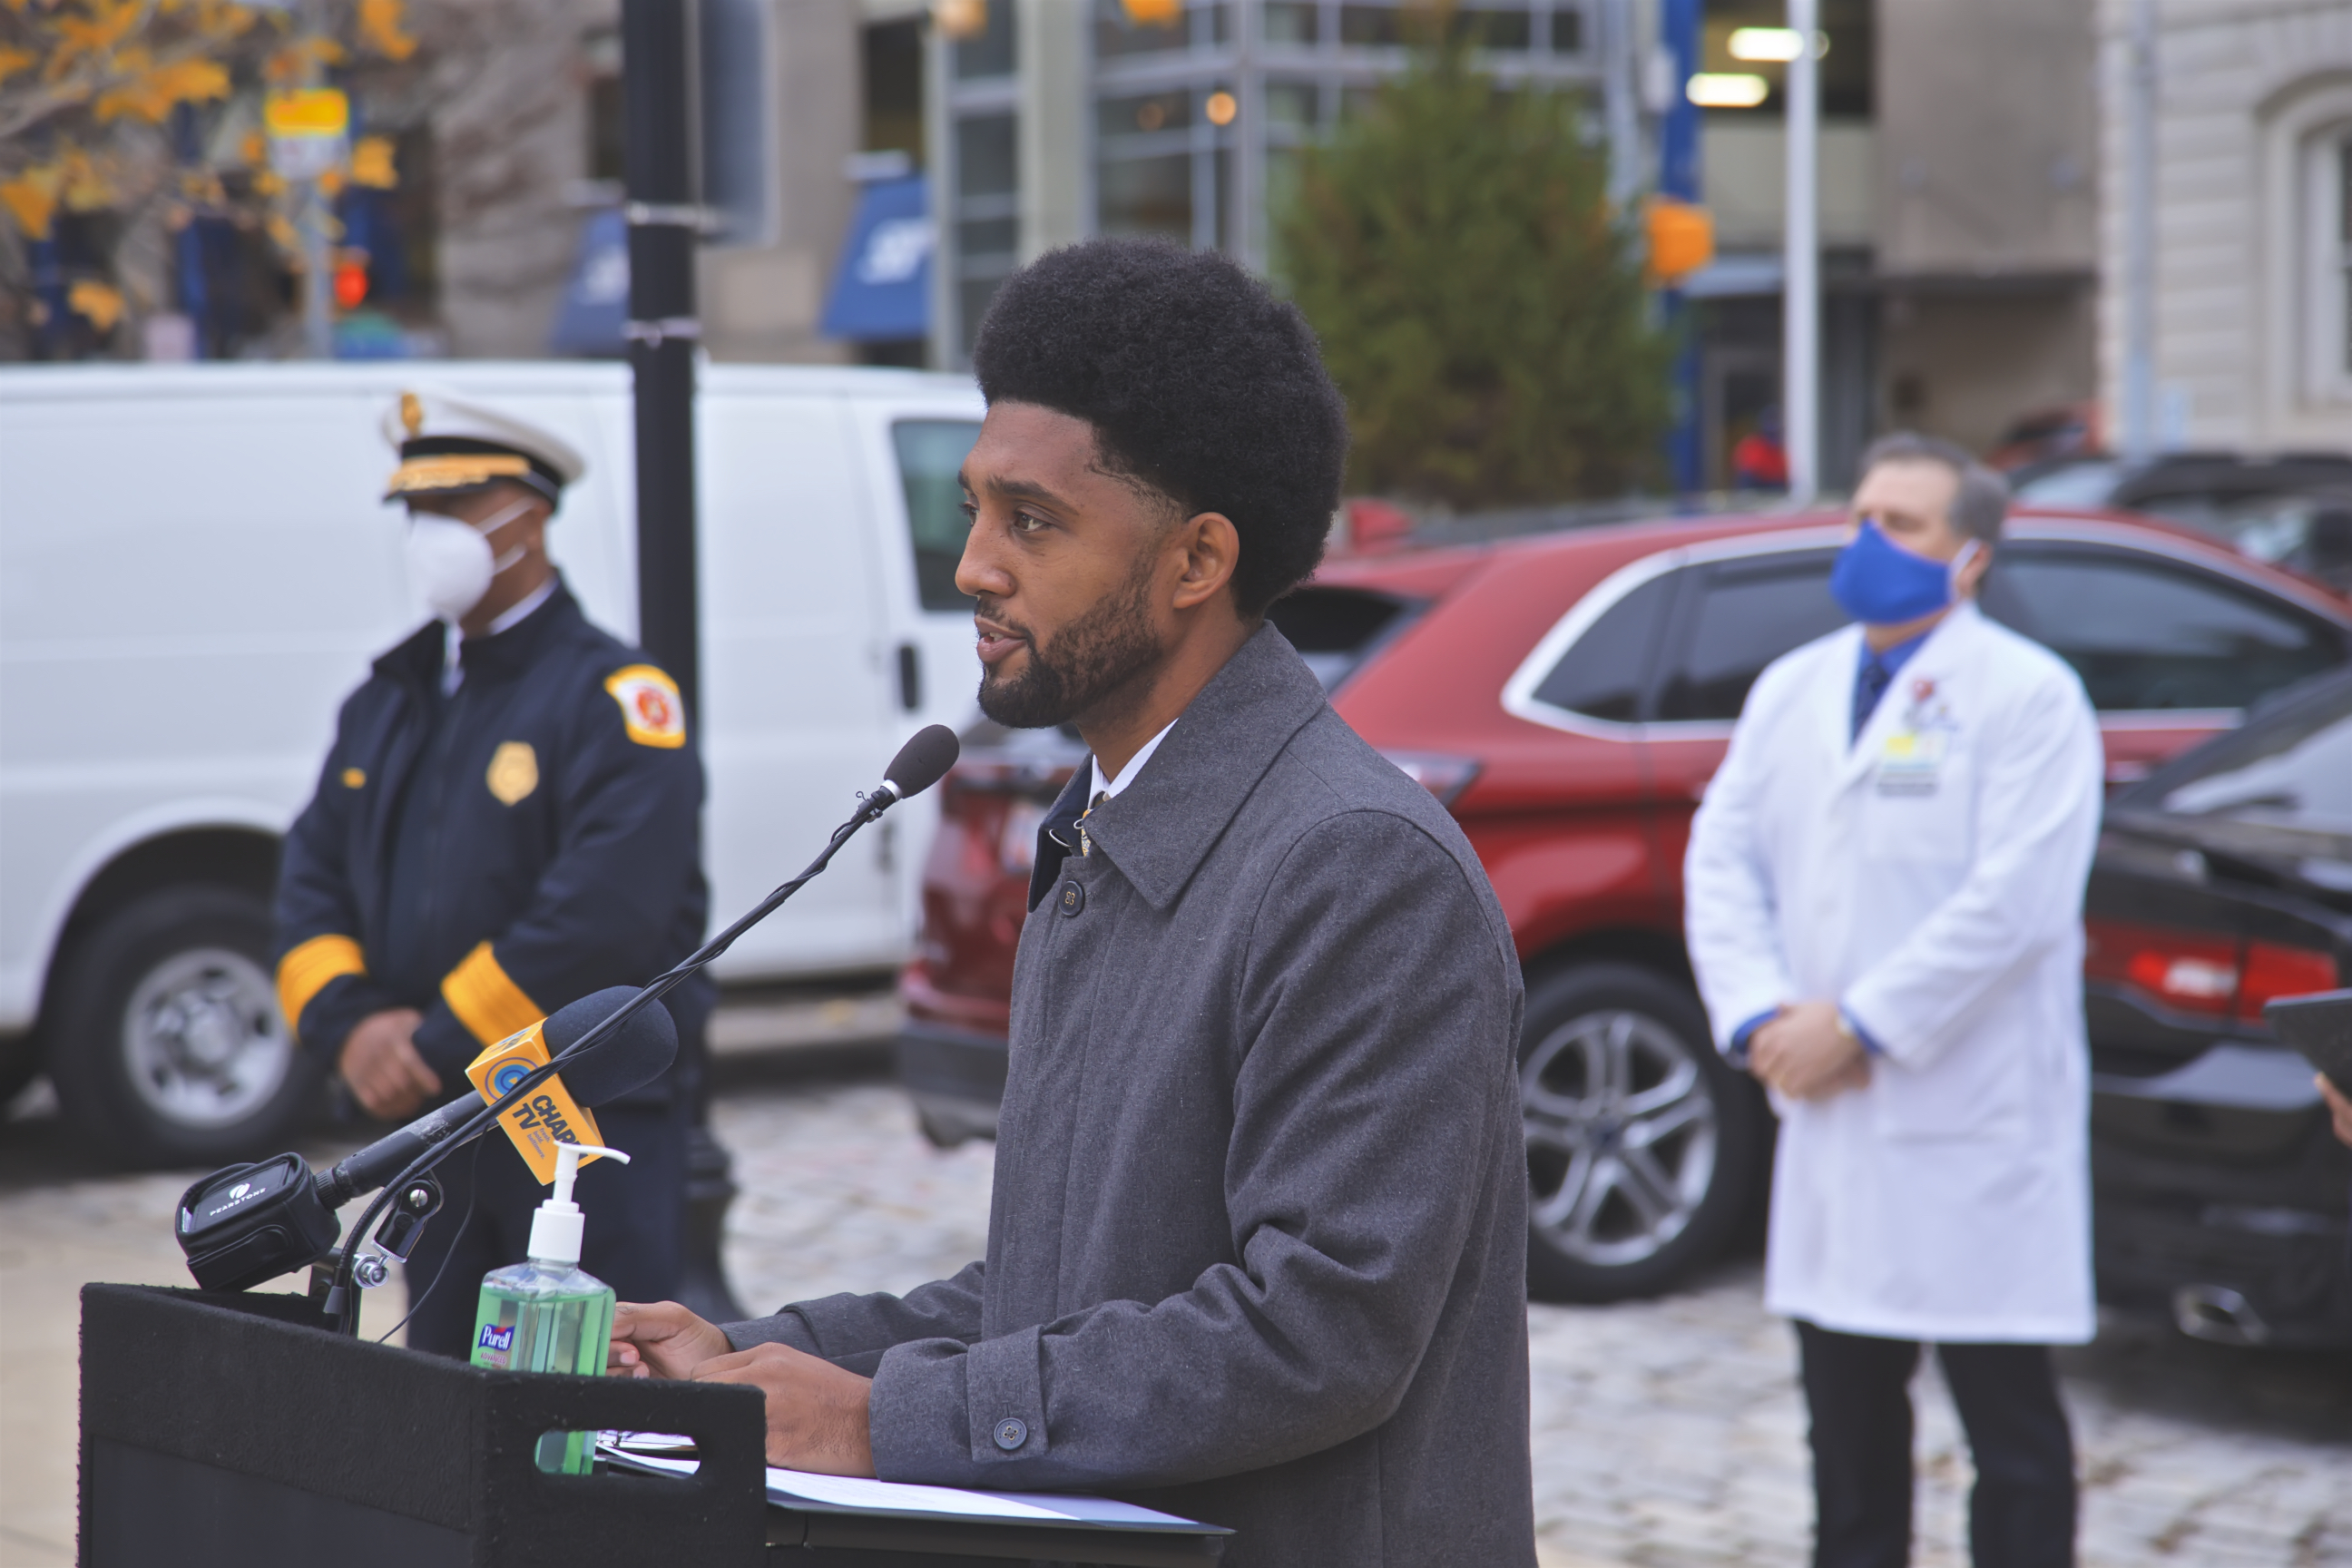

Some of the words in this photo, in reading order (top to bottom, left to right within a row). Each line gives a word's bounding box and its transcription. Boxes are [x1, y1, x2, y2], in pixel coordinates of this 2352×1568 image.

[512, 1102, 542, 1130] TV
[526, 1133, 545, 1160] baltimore.
[533, 1130, 544, 1144] bold.
[539, 1127, 551, 1143] fresh.
[209, 1187, 267, 1217] PEARSTONE
[481, 1325, 512, 1351] Purell
[480, 1352, 507, 1366] ADVANCED
